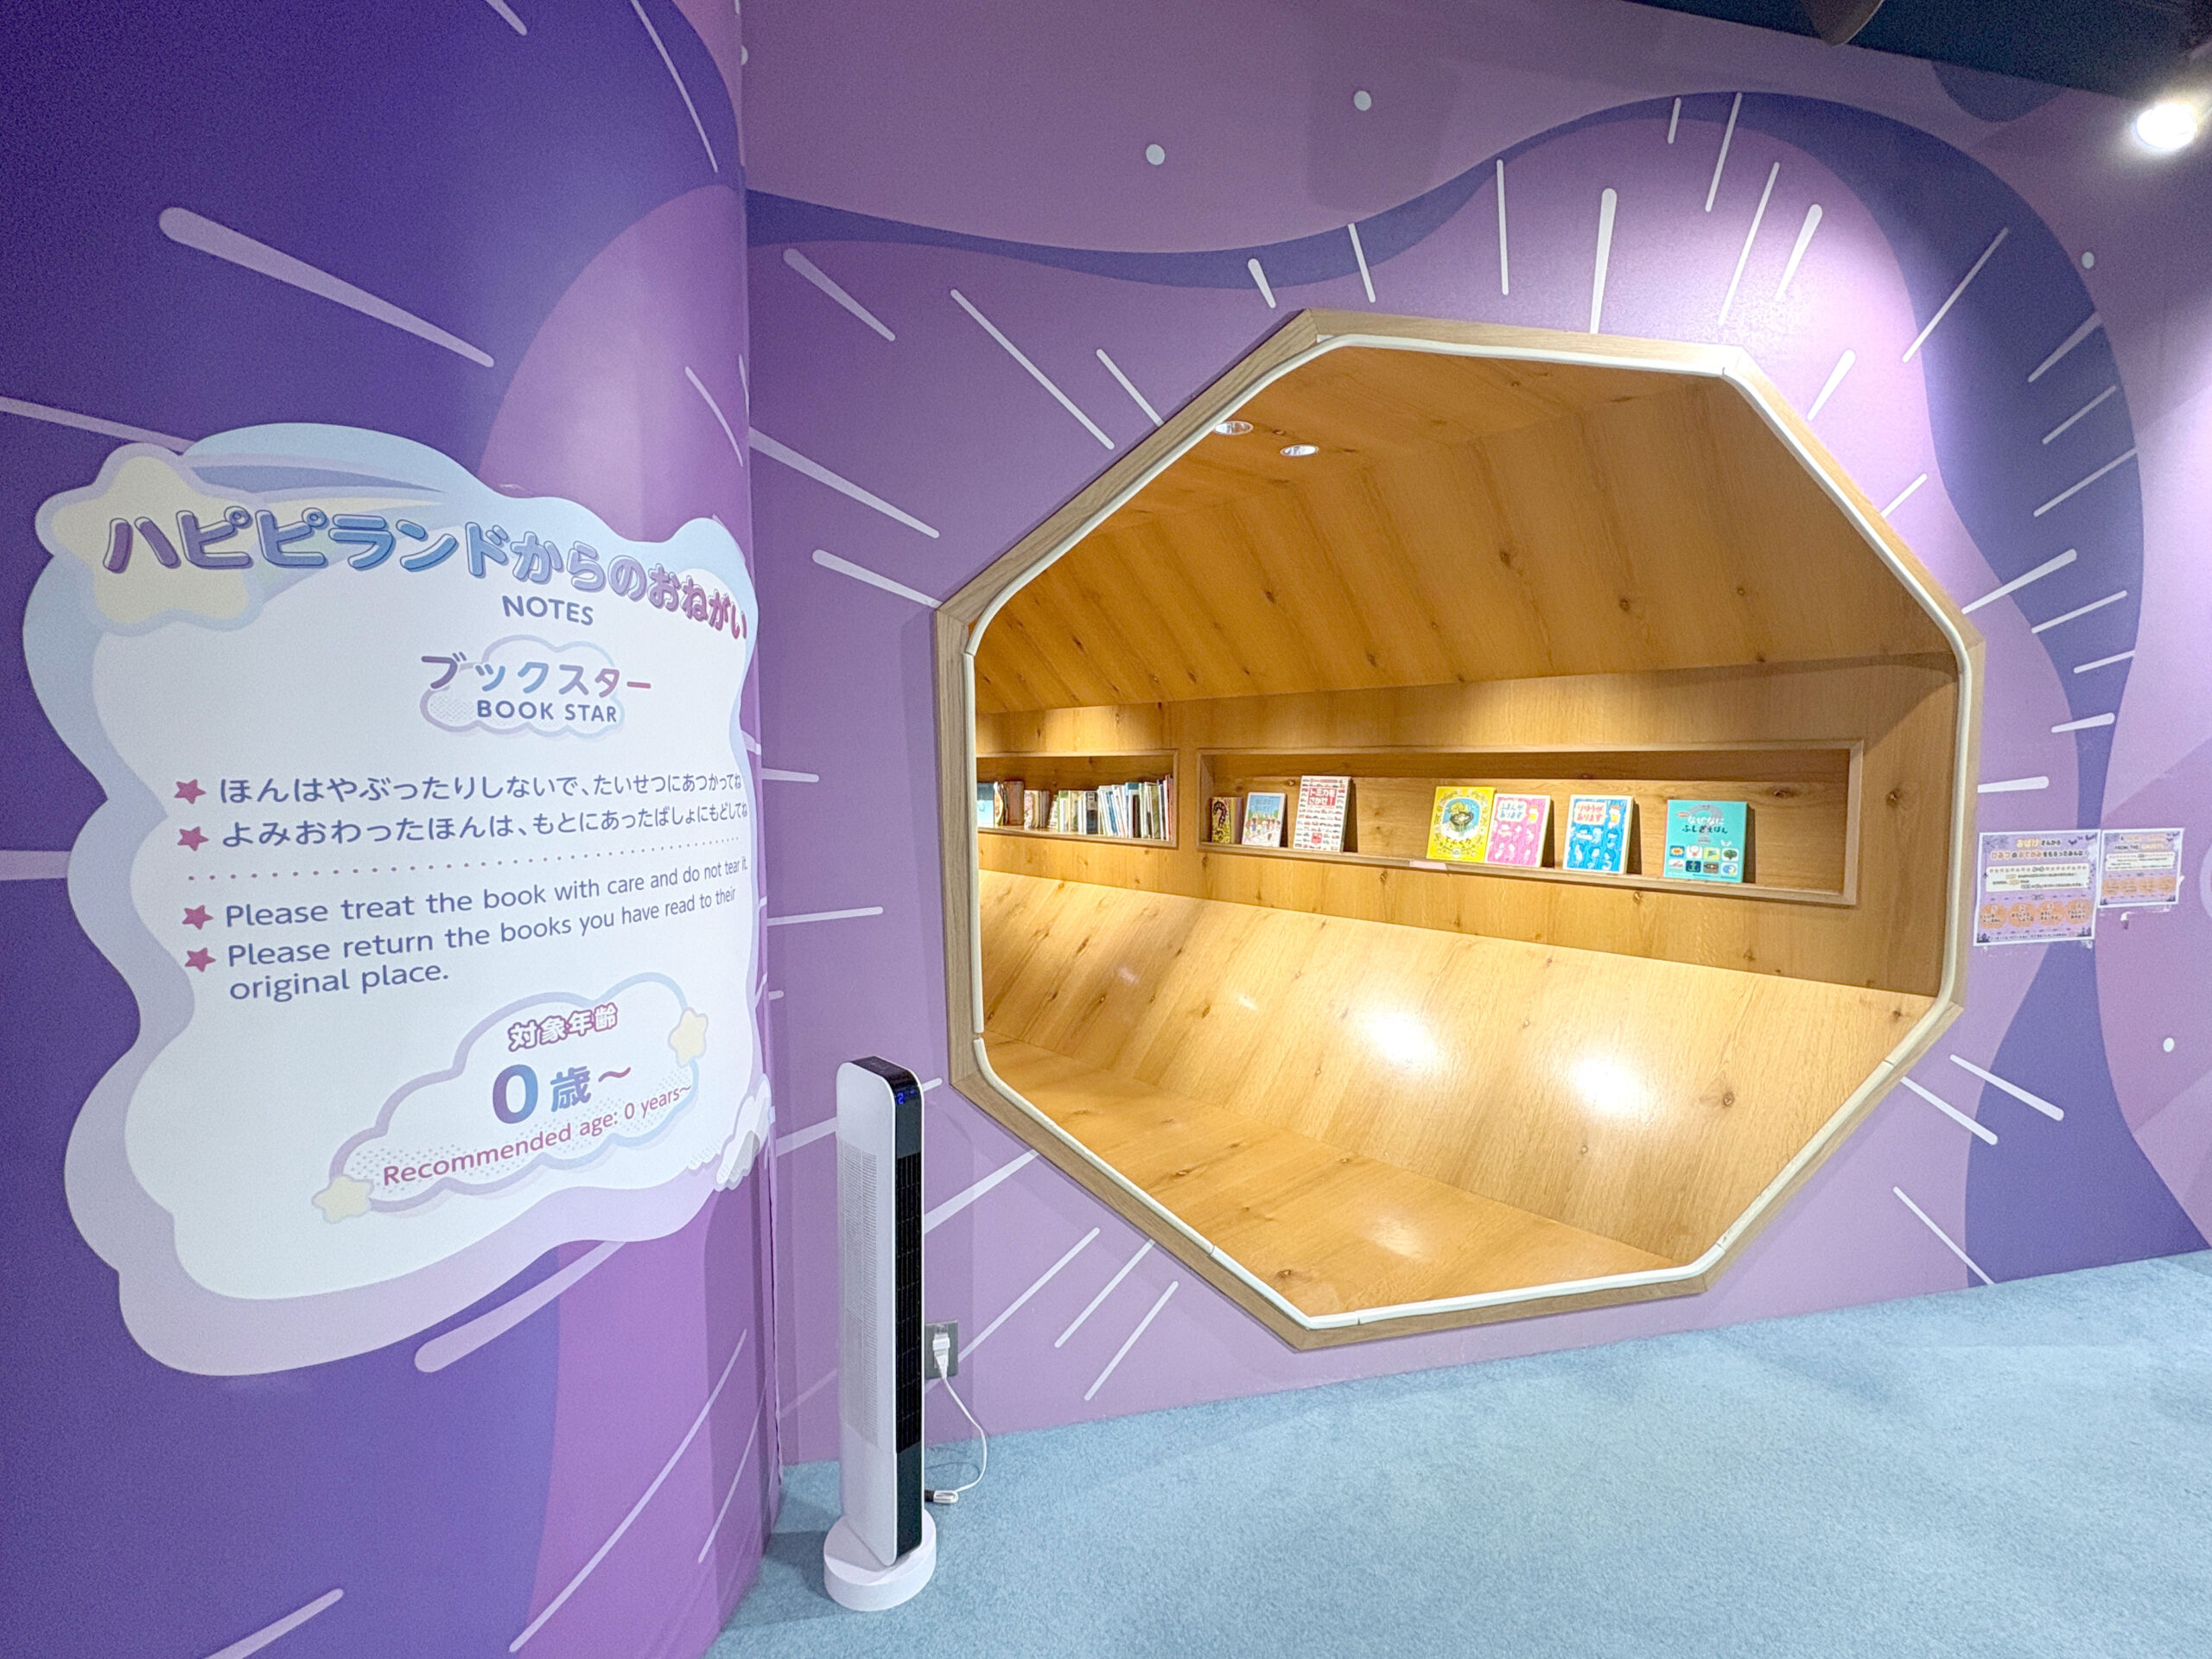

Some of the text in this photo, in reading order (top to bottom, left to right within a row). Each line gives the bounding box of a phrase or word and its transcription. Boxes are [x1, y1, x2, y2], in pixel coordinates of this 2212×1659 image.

[103, 505, 747, 640] ハピピランドからのおねがい
[501, 594, 594, 626] NOTES
[420, 651, 652, 698] ブックスター
[476, 700, 619, 723] BOOK STAR
[219, 772, 742, 804] ほんはやぶったりしないで、たいせつにあつかってね
[221, 801, 749, 848] よみおわったほんは、もとにあったばしょにもどしてね
[226, 903, 329, 928] Please
[340, 895, 416, 920] treat
[425, 892, 474, 914] the
[483, 884, 548, 909] book
[554, 878, 601, 901] with
[607, 876, 645, 894] care
[650, 867, 678, 889] and
[682, 865, 701, 883] do
[703, 861, 722, 880] not
[723, 857, 741, 875] tear
[227, 885, 737, 968] Please return the books you have read to their
[229, 964, 450, 1003] original place.
[507, 1001, 619, 1052] 対象年齢
[383, 1122, 573, 1186] Recommended
[579, 1109, 620, 1138] age:
[623, 1103, 635, 1121] 0
